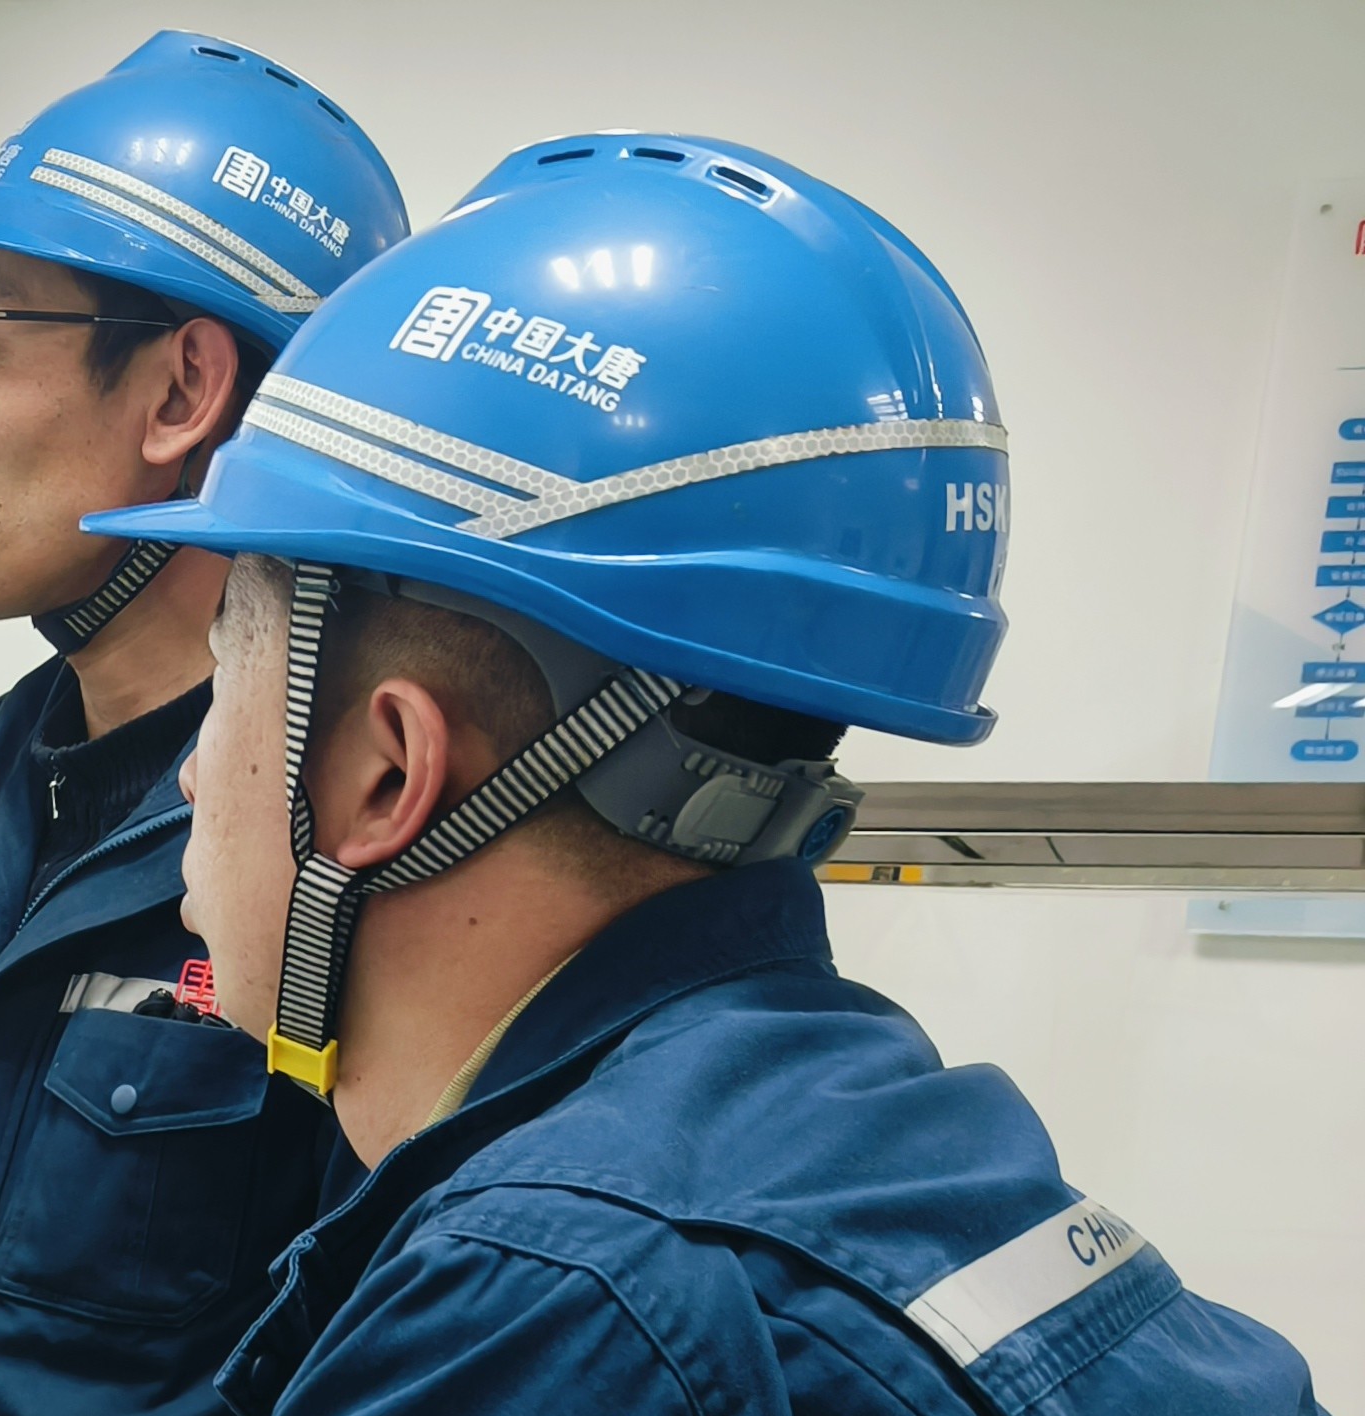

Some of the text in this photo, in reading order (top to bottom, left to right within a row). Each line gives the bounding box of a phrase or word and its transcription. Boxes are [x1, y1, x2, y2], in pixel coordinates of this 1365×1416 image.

[260, 192, 344, 260] CHINA DATANG
[269, 174, 352, 247] 中国大唐
[461, 341, 621, 413] CHINA DATANG
[482, 306, 647, 390] 中国大唐
